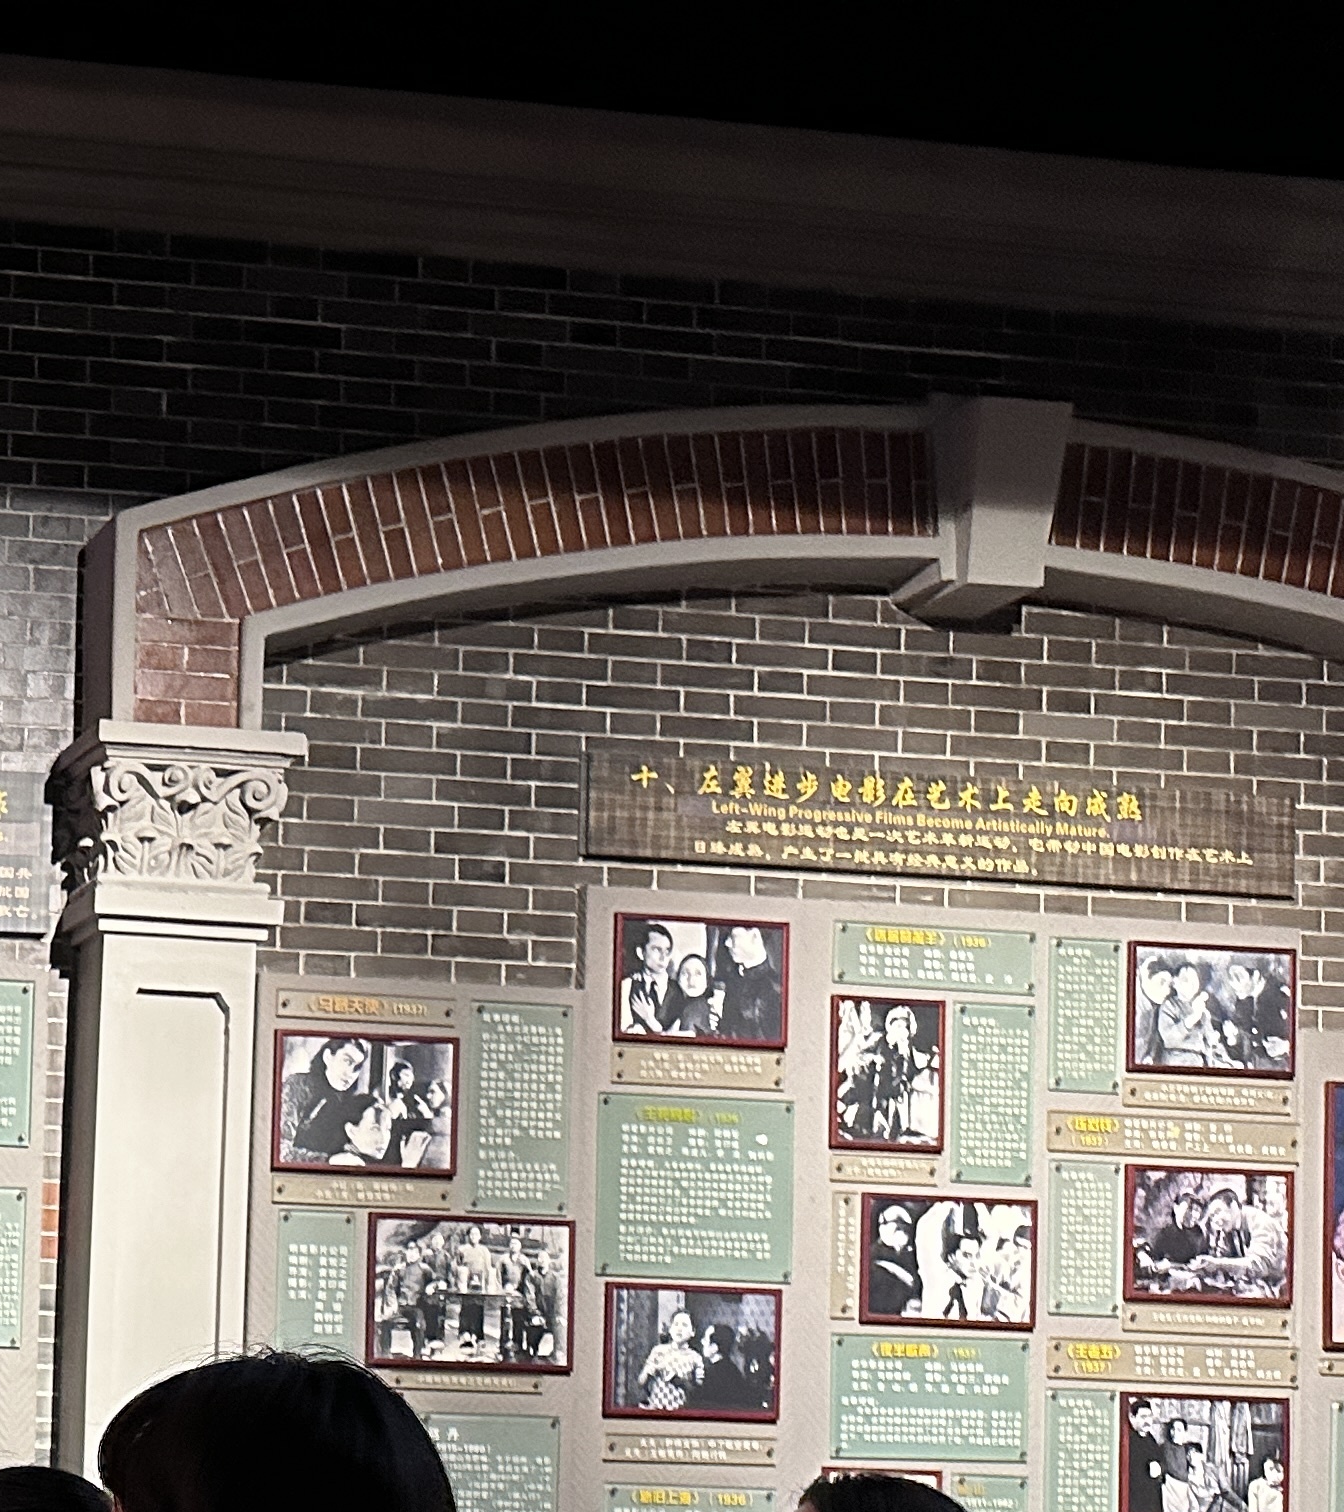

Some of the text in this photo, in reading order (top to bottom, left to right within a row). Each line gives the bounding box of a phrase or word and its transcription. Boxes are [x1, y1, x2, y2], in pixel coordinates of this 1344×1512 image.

[631, 763, 1142, 822] 十、左翼进步电影在艺术上走向成熟
[712, 800, 1111, 839] Left-Wing Progressive Films Become Artistically Mature.
